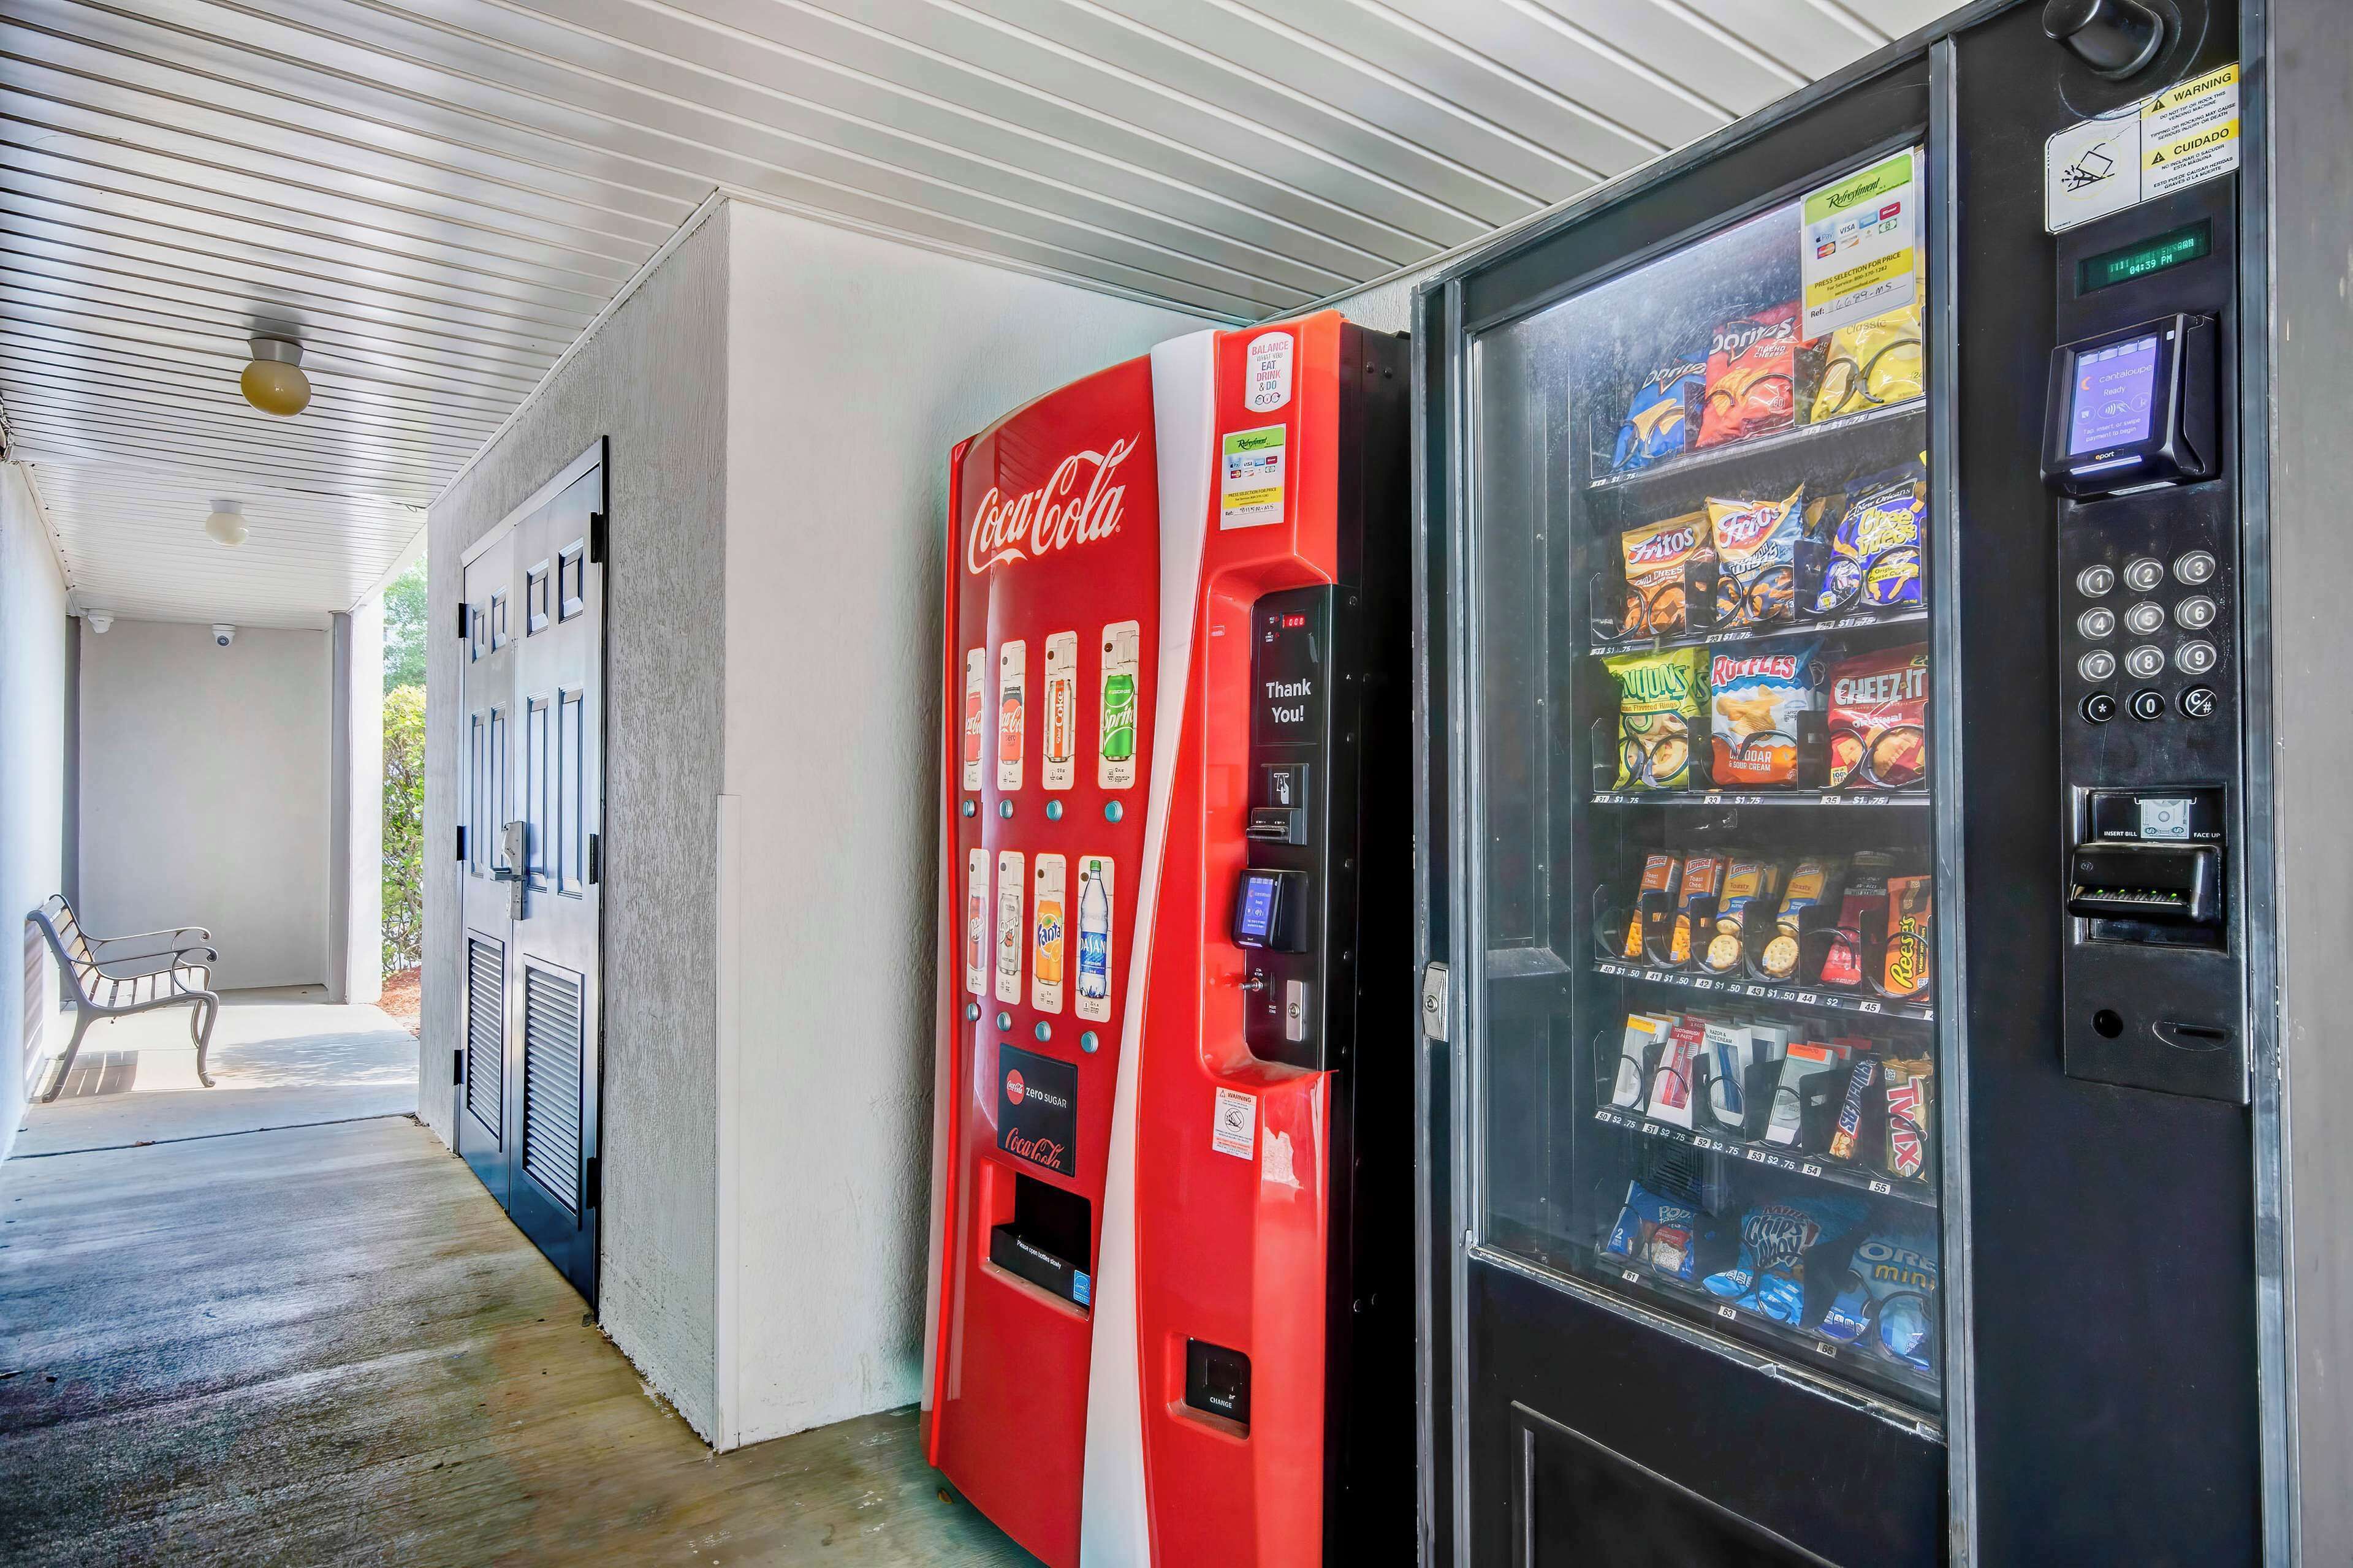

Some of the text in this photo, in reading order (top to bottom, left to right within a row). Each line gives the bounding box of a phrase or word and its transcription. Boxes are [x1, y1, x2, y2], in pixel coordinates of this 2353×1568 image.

[2174, 73, 2232, 102] WARNING
[2169, 109, 2181, 118] NOT
[2197, 96, 2213, 107] ROCK
[2169, 100, 2216, 121] VENDING MACHINE
[2150, 127, 2170, 138] TIPPING
[2180, 114, 2204, 126] ROCKING
[2218, 102, 2236, 112] CAUSE
[2157, 129, 2181, 141] SERIOUS
[2181, 122, 2200, 132] INJURY
[2210, 111, 2228, 121] DEATH
[2174, 128, 2229, 154] CUIDADO
[2170, 155, 2194, 167] INCLINAR
[2201, 144, 2225, 156] SACUDIR
[2164, 178, 2186, 189] GRAVES
[2200, 166, 2222, 178] MUERTE
[2169, 173, 2186, 183] PUEDE
[2187, 165, 2208, 176] CAUSAR
[2210, 156, 2233, 168] HERIDAS
[1826, 177, 1880, 208] Refreshment
[1839, 224, 1855, 234] VISA
[1814, 278, 1833, 289] PRESS
[1834, 264, 1868, 281] SELECTION
[1868, 259, 1882, 268] FOR
[1882, 251, 1901, 263] PRICE
[2129, 254, 2173, 275] 04:39 PM
[1811, 309, 1825, 318] Ref:
[1847, 319, 1887, 335] Classic
[1252, 341, 1289, 355] BALANCE
[1256, 369, 1281, 382] DRINK
[1261, 360, 1276, 371] EAT
[2099, 363, 2153, 384] cantaloupe
[1259, 380, 1277, 392] & DO
[2104, 385, 2126, 396] Ready
[2123, 417, 2141, 427] swipe
[2085, 431, 2112, 442] payment
[2119, 426, 2137, 437] begin
[968, 431, 1141, 574] Coca-Cola
[1857, 488, 1910, 513] New Orleans
[1859, 507, 1914, 536] Chee
[1629, 528, 1695, 564] Fritos
[2096, 561, 2204, 588] 1 2 3
[2096, 606, 2204, 631] 4 5 6
[1712, 654, 1797, 686] RUFFLES
[2097, 651, 2205, 673] 7 8 9
[1266, 678, 1312, 699] Thank
[1055, 691, 1064, 727] Coke
[1272, 705, 1304, 723] You!
[1659, 702, 1678, 710] Rings
[2146, 699, 2156, 713] 0
[1749, 763, 1771, 772] CREAM
[1037, 921, 1061, 947] Fanta
[1827, 998, 1838, 1007] $2
[1026, 1087, 1043, 1100] zero
[1044, 1094, 1067, 1108] SUGAR
[1228, 1093, 1252, 1103] WARNING
[1887, 1077, 1922, 1170] TWIX
[1807, 1166, 1887, 1193] 54 55
[1615, 1228, 1623, 1240] 2
[1017, 1240, 1062, 1270] Please open bottles slowly
[1723, 1308, 1733, 1317] 63
[1822, 1345, 1834, 1354] 65
[1210, 1396, 1233, 1409] CHANGE
